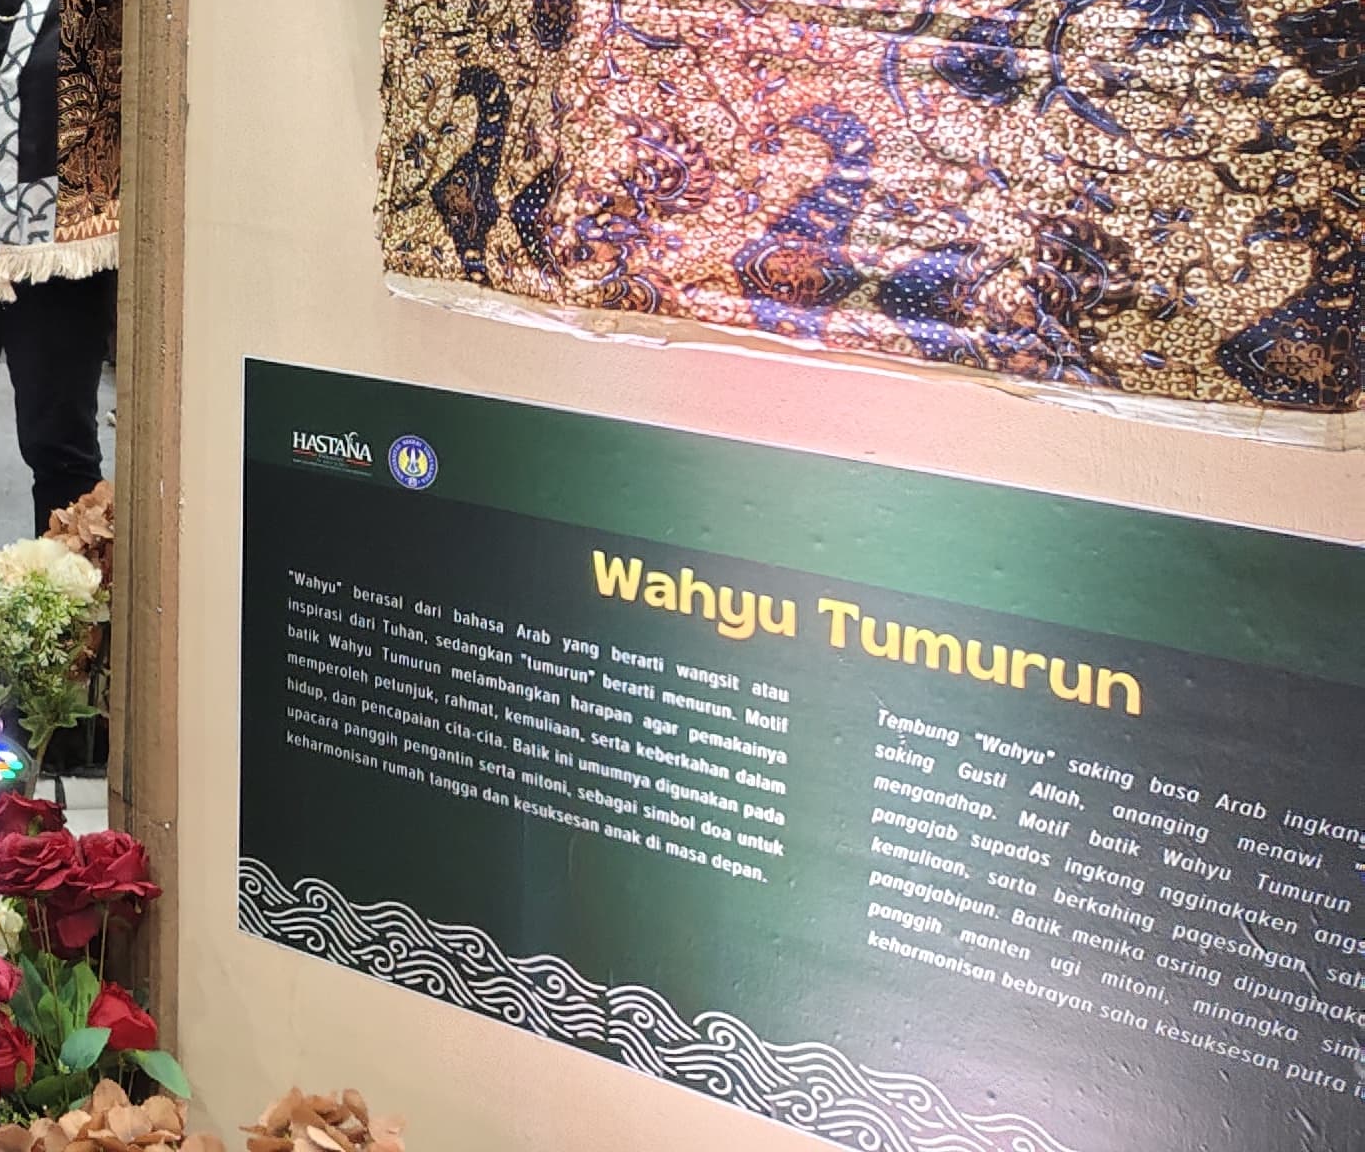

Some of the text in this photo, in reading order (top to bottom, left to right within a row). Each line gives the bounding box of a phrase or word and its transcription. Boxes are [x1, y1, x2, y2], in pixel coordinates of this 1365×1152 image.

[288, 597, 789, 733] inspirasi dari Tuhan, sedangkan "tumurun" berarti menurun. Motif
[288, 623, 788, 765] batik Wahyu Tumurun melambangkan harapan agar pemakainya
[289, 570, 790, 703] "Wahyu" berasal dari bahasa Arab yang berarti wangsit atau
[592, 549, 1143, 716] Wahyu Tumurun
[287, 677, 785, 826] hidup, dan pencapaian cita-cita. Batik ini umumnya digunakan pada
[287, 706, 784, 857] upacara panggih pengantin serta mitoni, sebagai simbol doa untuk
[288, 653, 786, 795] memperoleh petunjuk, rahmat, kemuliaan, serta keberkahan dalam
[877, 708, 961, 748] Tembung
[975, 732, 1056, 765] "Wahyu"
[1068, 759, 1134, 790] saking
[1150, 776, 1200, 803] basa
[1215, 793, 1266, 819] Arab
[287, 730, 768, 883] keharmonisan rumah tangga dan kesuksesan anak di masa depan.
[871, 807, 958, 841] pangajab
[971, 834, 1051, 867] supados
[1065, 857, 1145, 896] ingkang
[1159, 885, 1299, 936] ngginakaken
[873, 776, 1351, 913] mengandhap. Motif batik Wahyu Tumurun
[874, 743, 1323, 869] saking Gusti Allah, ananging menawi
[867, 902, 942, 934] panggih
[959, 929, 1031, 961] manten
[1050, 956, 1082, 977] ugi
[1101, 972, 1173, 1005] mitoni,
[1193, 1000, 1299, 1041] minangka
[869, 870, 1001, 919] pangajabipun.
[1011, 908, 1062, 937] Batik
[1072, 929, 1145, 961] menika
[1156, 954, 1222, 987] asring
[871, 836, 970, 879] kemuliaan,
[987, 872, 1037, 896] sarta
[1053, 887, 1157, 937] berkahing
[1171, 922, 1307, 974] pagesangan
[867, 930, 996, 983] keharmonisan
[1001, 971, 1093, 1013] bebrayan
[1099, 1005, 1148, 1030] saha
[1155, 1017, 1279, 1071] kesuksesan
[1286, 1064, 1346, 1092] putra
